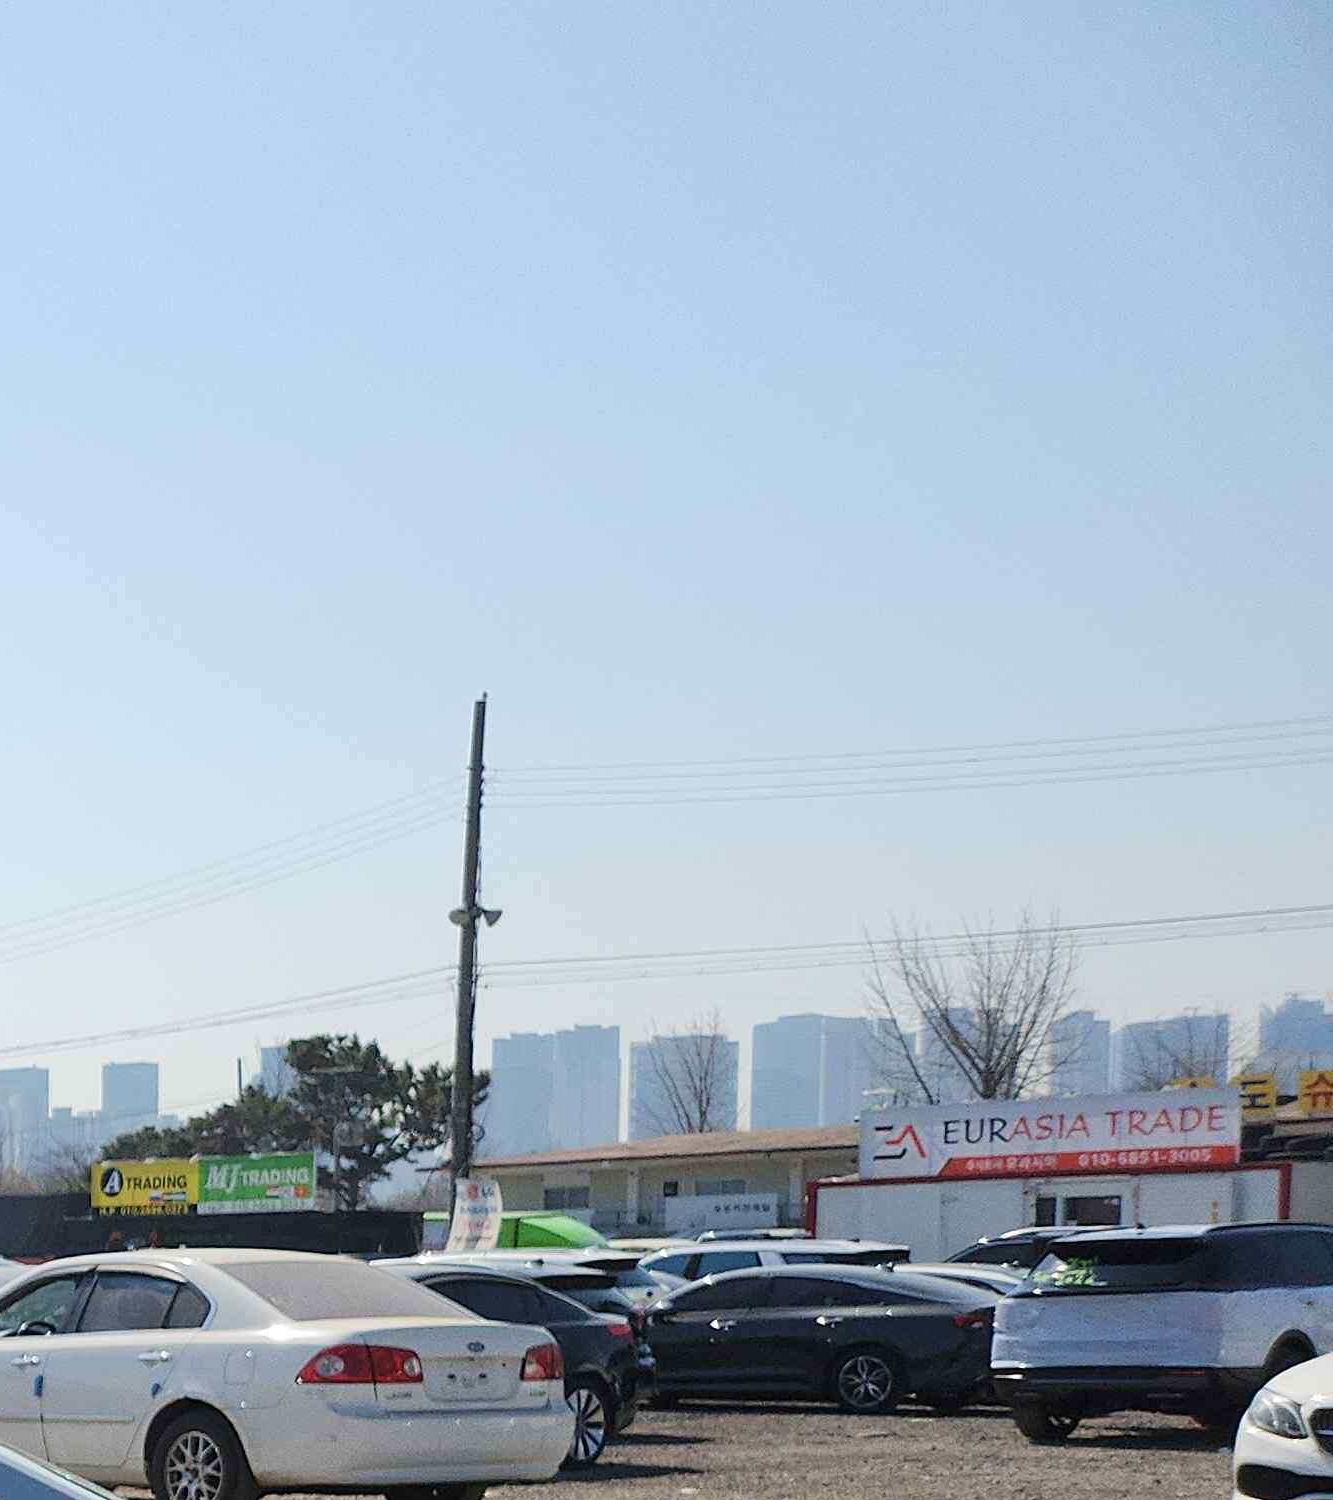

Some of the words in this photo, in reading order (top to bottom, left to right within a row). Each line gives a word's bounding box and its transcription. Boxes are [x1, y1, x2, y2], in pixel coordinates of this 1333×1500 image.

[943, 1113, 1091, 1145] EURASIA
[1105, 1104, 1226, 1137] TRADE
[126, 1174, 188, 1191] TRADING
[242, 1167, 310, 1187] TRADING
